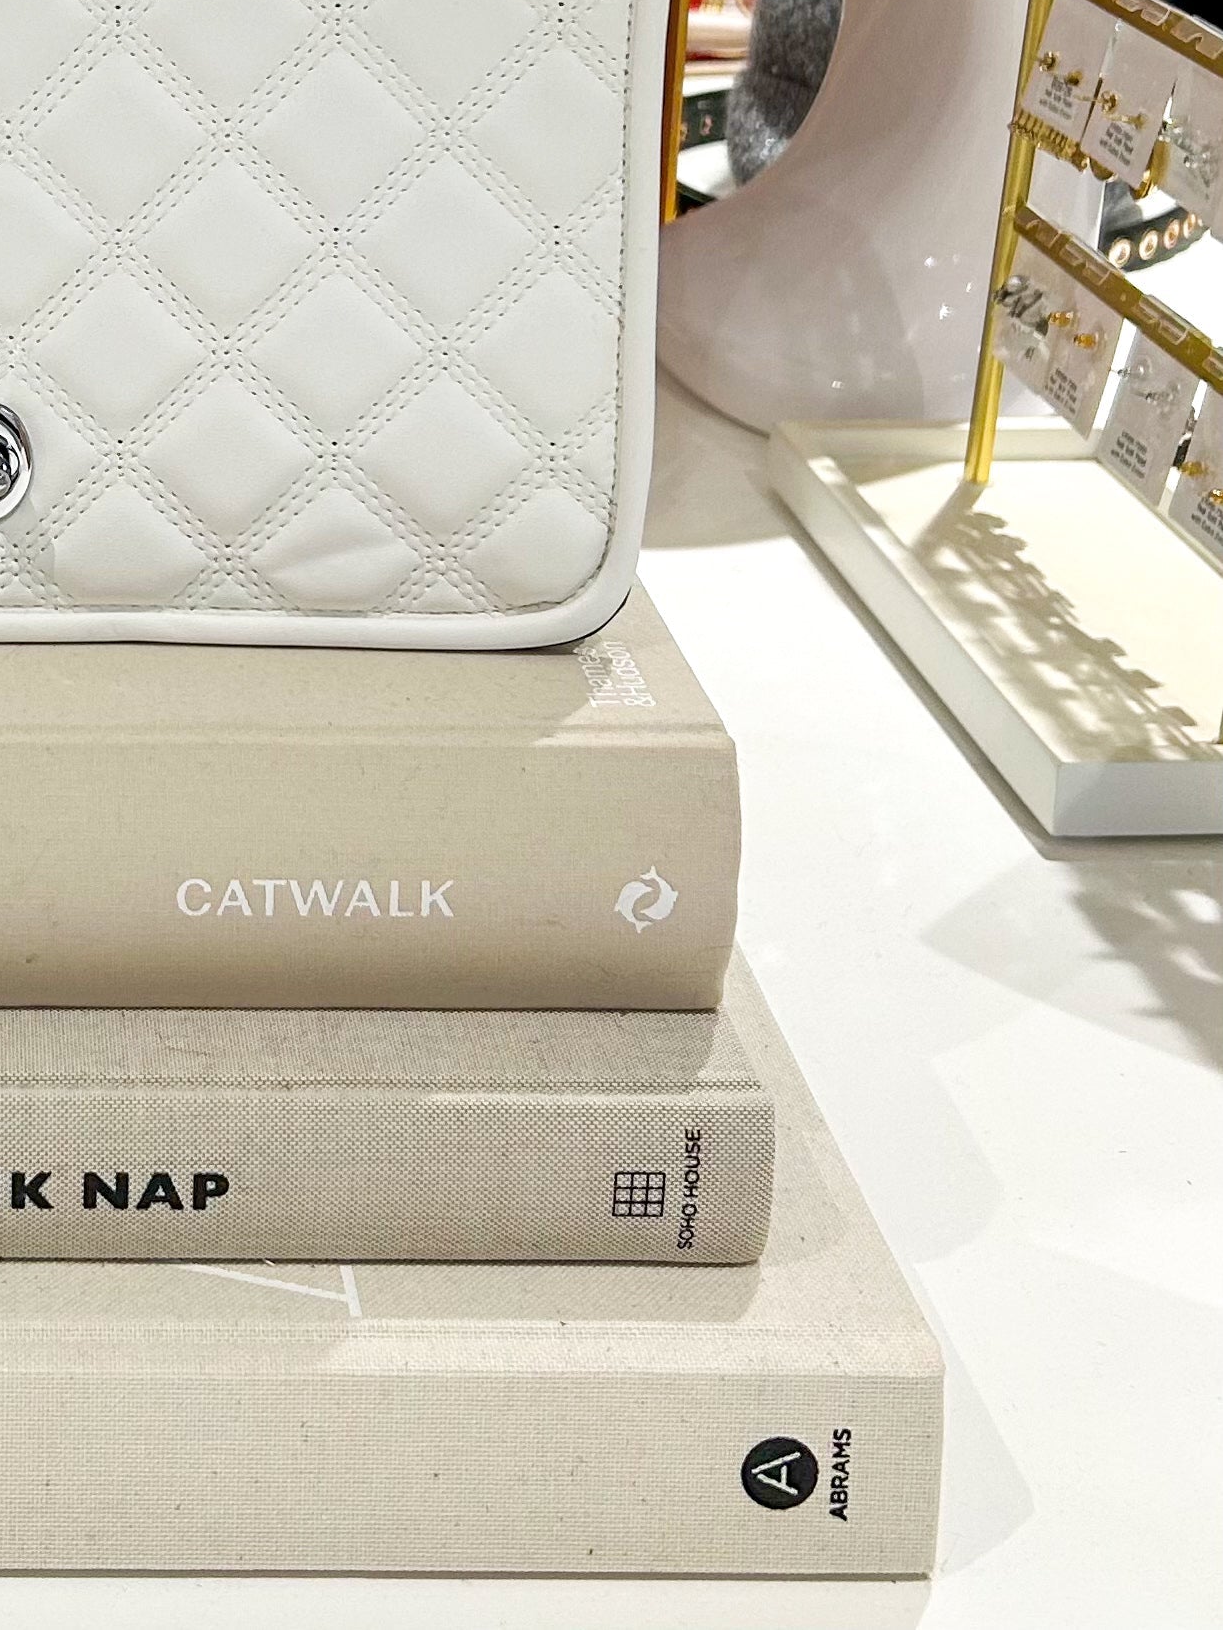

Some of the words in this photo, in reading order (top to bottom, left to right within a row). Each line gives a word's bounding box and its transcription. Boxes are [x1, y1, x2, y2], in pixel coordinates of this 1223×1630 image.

[175, 877, 455, 918] CATWALK
[683, 1128, 702, 1198] HOUSE
[82, 1171, 231, 1212] NAP
[676, 1202, 698, 1250] SOHO
[829, 1427, 852, 1522] ABRAMS
